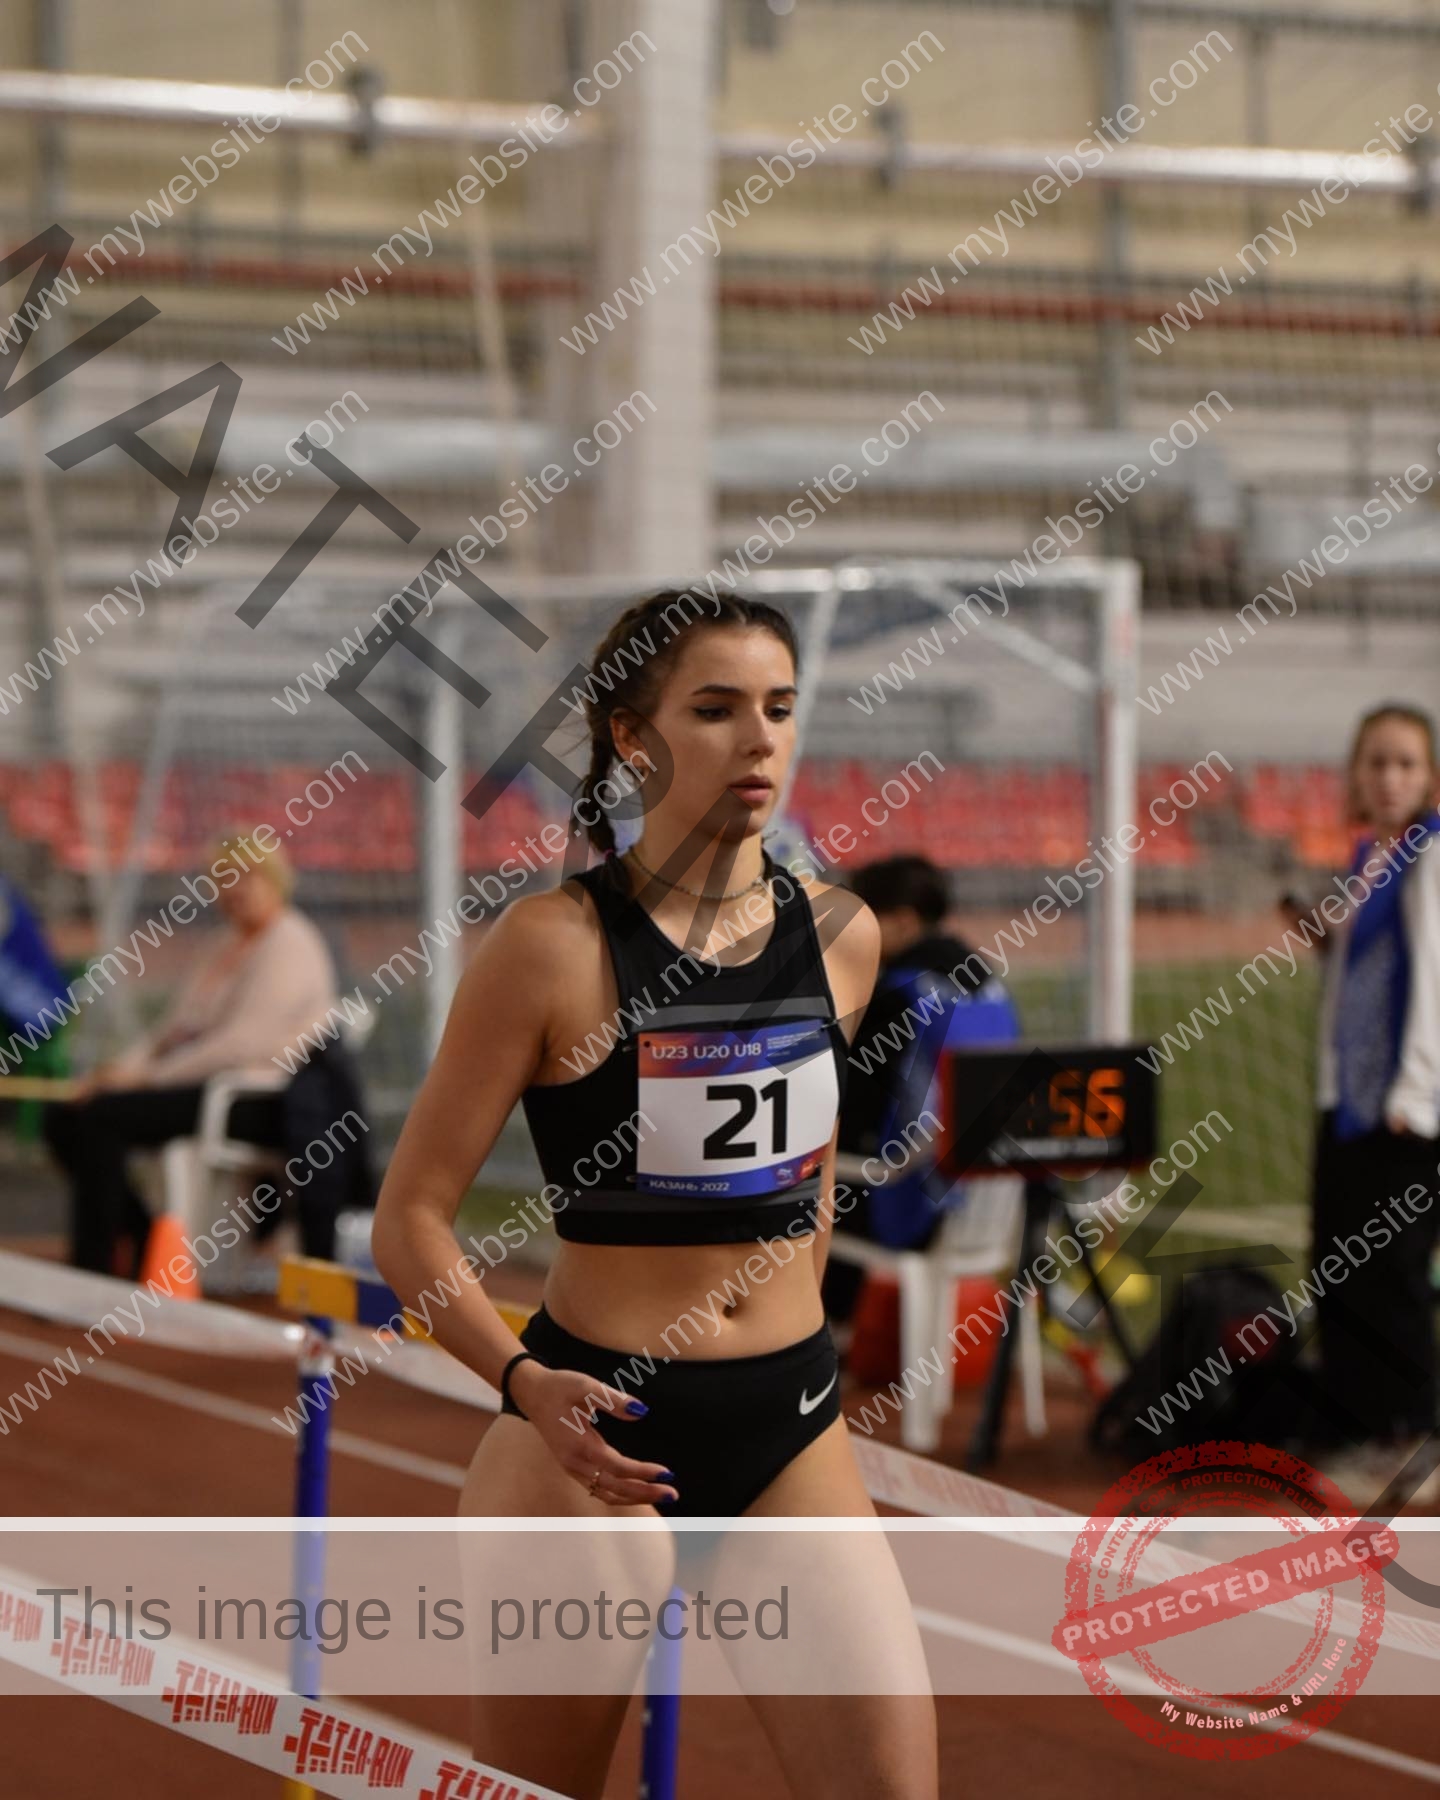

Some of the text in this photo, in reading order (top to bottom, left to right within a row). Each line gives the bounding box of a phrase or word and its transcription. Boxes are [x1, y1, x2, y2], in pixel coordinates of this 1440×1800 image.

[652, 1046, 688, 1060] U23
[693, 1045, 729, 1058] U20
[734, 1042, 761, 1057] U18
[703, 1078, 787, 1160] 21
[702, 1181, 730, 1192] 2022
